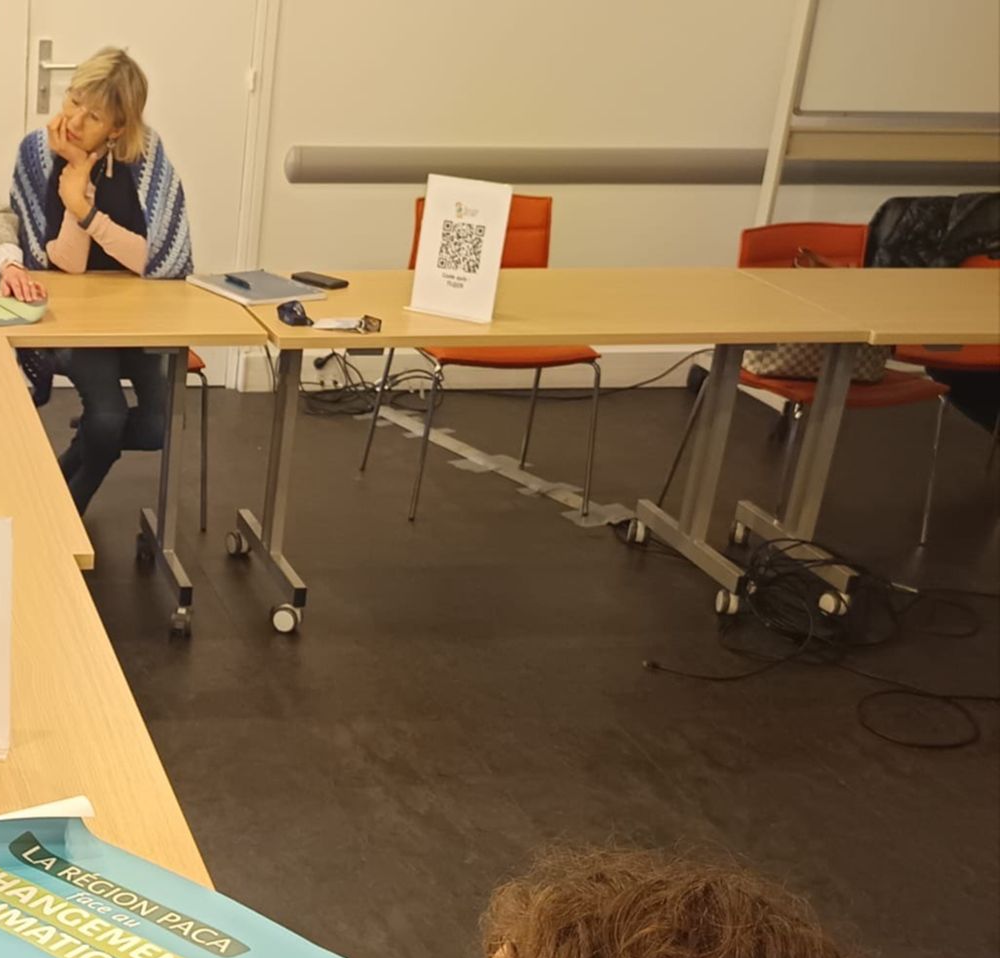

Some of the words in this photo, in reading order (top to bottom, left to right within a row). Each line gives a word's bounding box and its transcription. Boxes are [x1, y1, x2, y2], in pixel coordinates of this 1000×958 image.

[22, 846, 53, 871] LA
[57, 865, 158, 917] RÉGION
[160, 911, 234, 954] PACA
[66, 892, 112, 914] face
[112, 911, 141, 929] au
